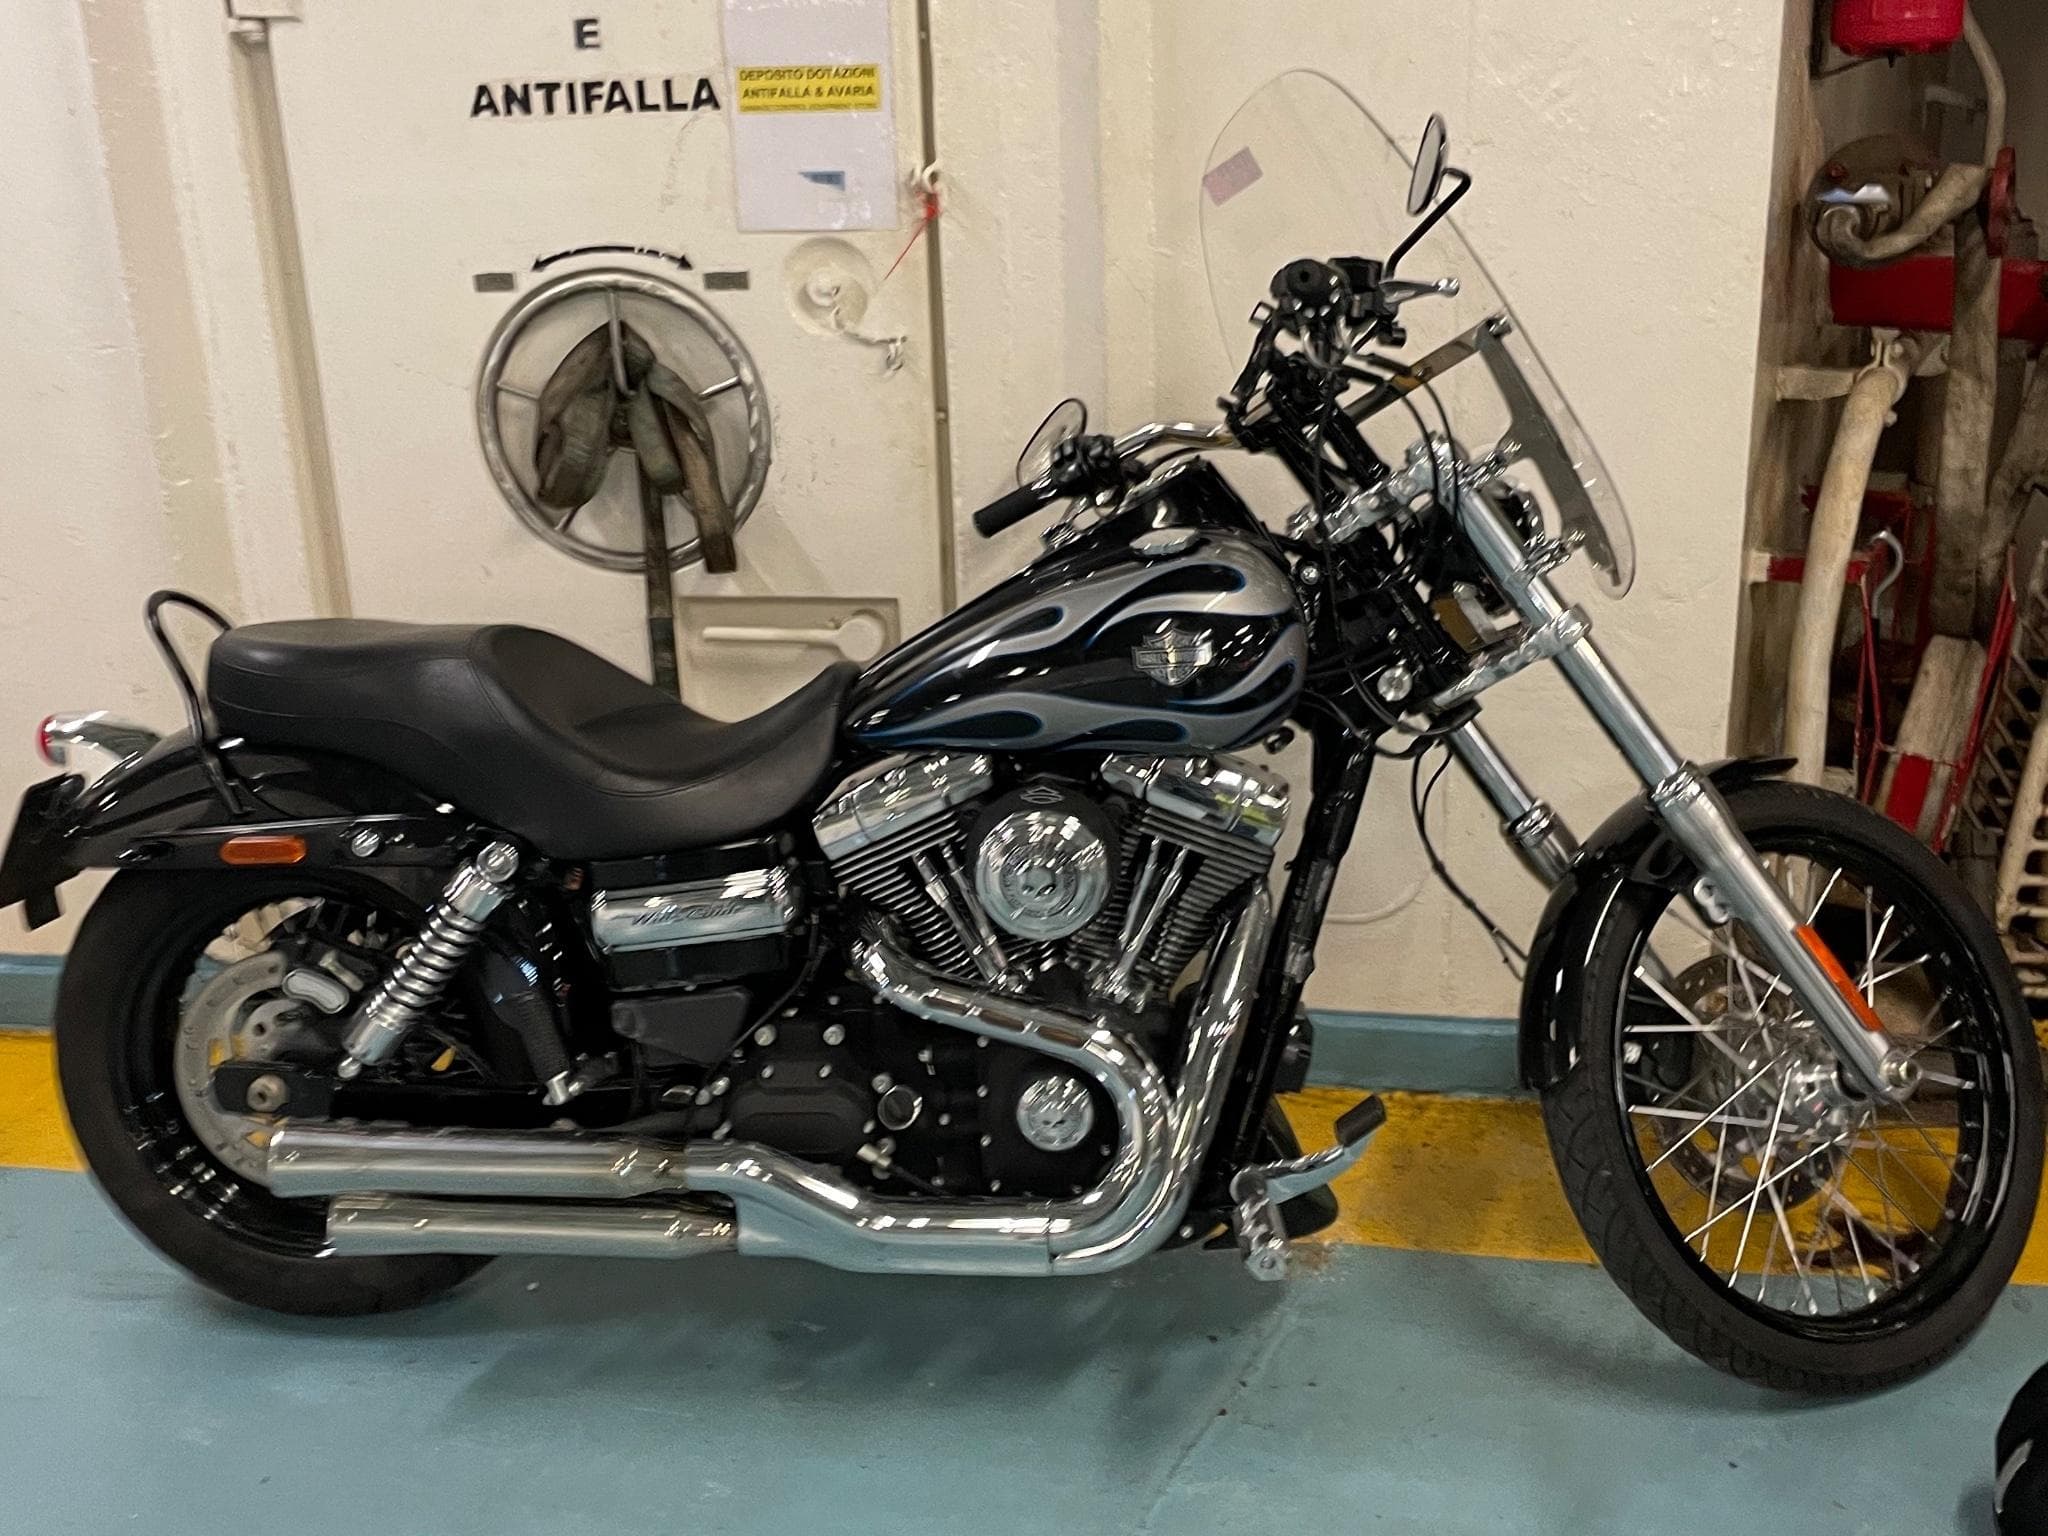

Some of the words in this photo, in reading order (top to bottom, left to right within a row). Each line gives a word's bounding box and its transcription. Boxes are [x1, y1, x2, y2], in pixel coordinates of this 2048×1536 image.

[574, 18, 600, 50] E
[470, 78, 721, 117] ANTIFALLA
[743, 86, 810, 98] ANTIFALLA
[827, 85, 874, 97] AVARIA
